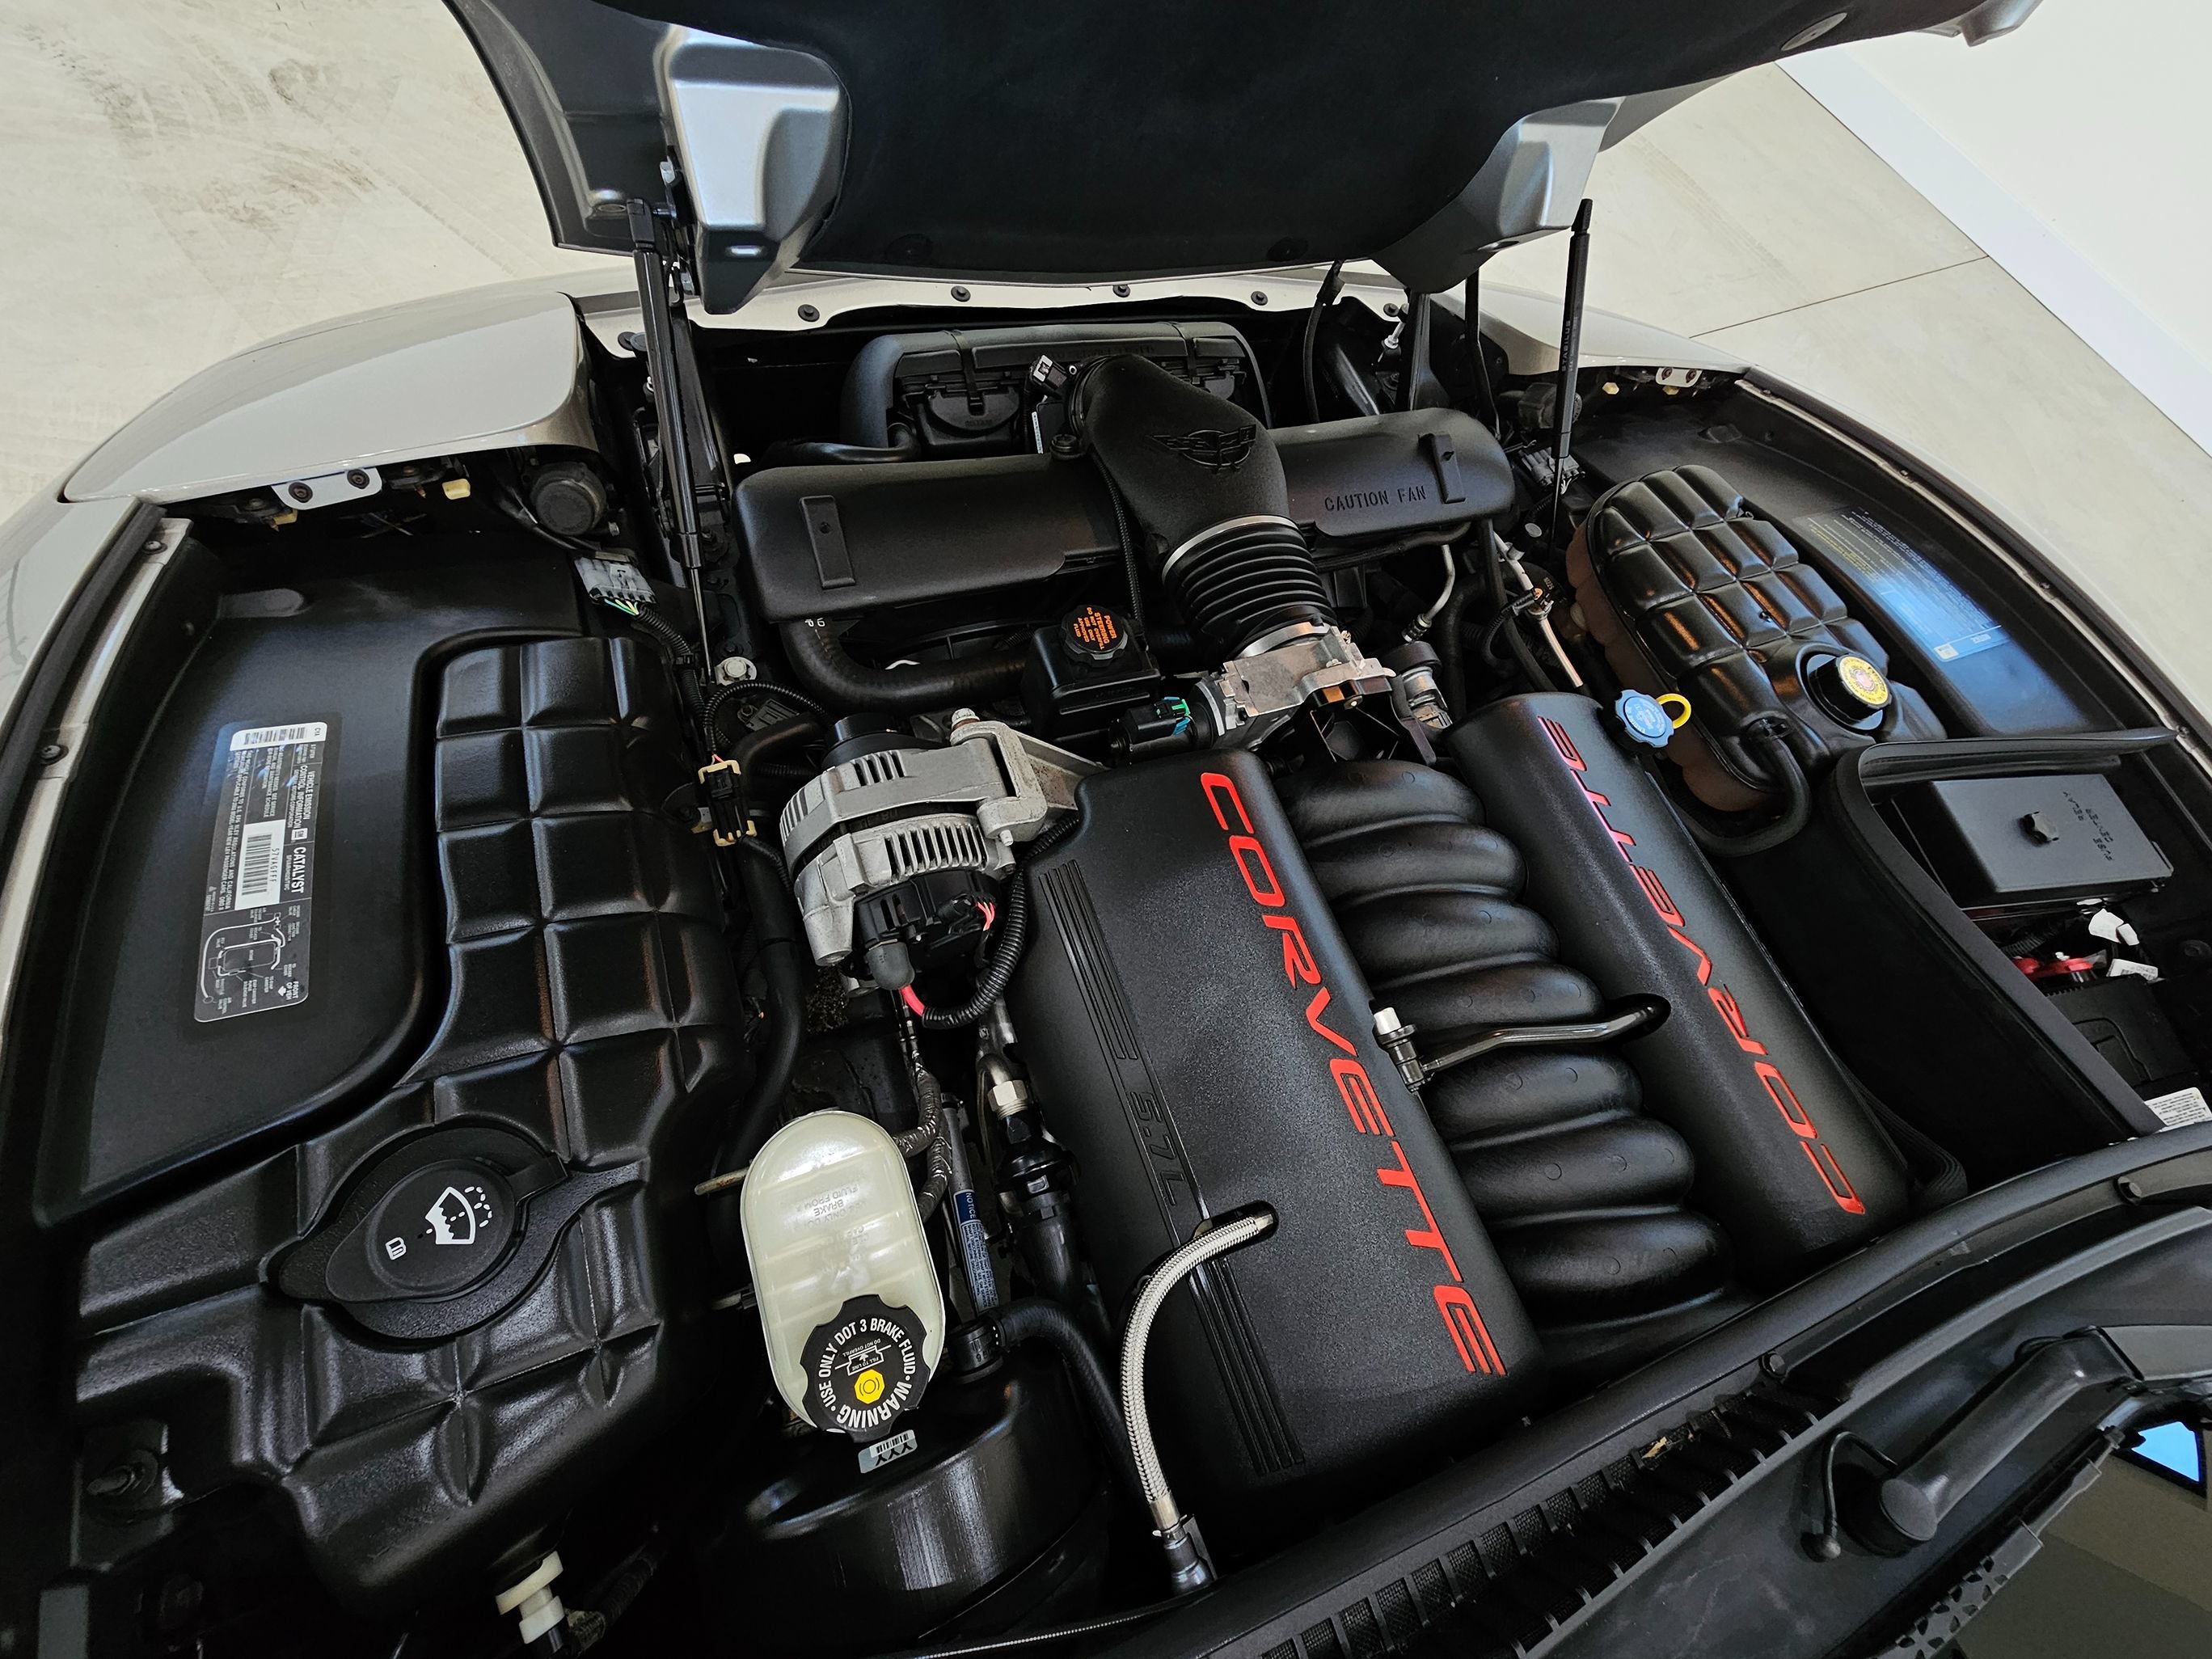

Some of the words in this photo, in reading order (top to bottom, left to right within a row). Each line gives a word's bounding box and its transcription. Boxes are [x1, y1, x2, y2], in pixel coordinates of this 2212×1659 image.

[1561, 319, 1571, 372] STABILUS
[1324, 490, 1390, 512] CAUTION
[1395, 485, 1427, 503] FAN
[1074, 623, 1082, 637] FLUID
[1077, 618, 1090, 642] APPROVED
[1088, 629, 1096, 641] ONLY
[1094, 627, 1104, 650] OVERFILL
[1095, 612, 1109, 644] STEERING
[1104, 615, 1117, 639] POWER
[297, 764, 308, 791] CONTROL
[304, 770, 315, 793] VEHICLE
[293, 790, 305, 829] INFORMATION
[302, 793, 313, 821] EMISSION
[2092, 838, 2113, 860] FUSE
[289, 846, 306, 895] CATALYST
[1538, 716, 1866, 1215] CORVETTE
[1199, 772, 1506, 1376] CORVETTE
[1125, 1089, 1192, 1205] 5.7L
[832, 1184, 858, 1200] FLUID
[813, 1199, 844, 1217] BRAKE
[965, 1193, 977, 1219] NOTICE
[834, 1322, 857, 1345] DOT
[860, 1319, 867, 1332] 3
[870, 1318, 905, 1342] BRAKE
[842, 1345, 864, 1357] OVERFILL
[863, 1340, 874, 1349] NOT
[898, 1339, 915, 1374] FLUID
[818, 1342, 838, 1378] ONLY
[851, 1362, 863, 1371] LINE
[819, 1380, 836, 1408] USE
[836, 1381, 912, 1428] WARNING
